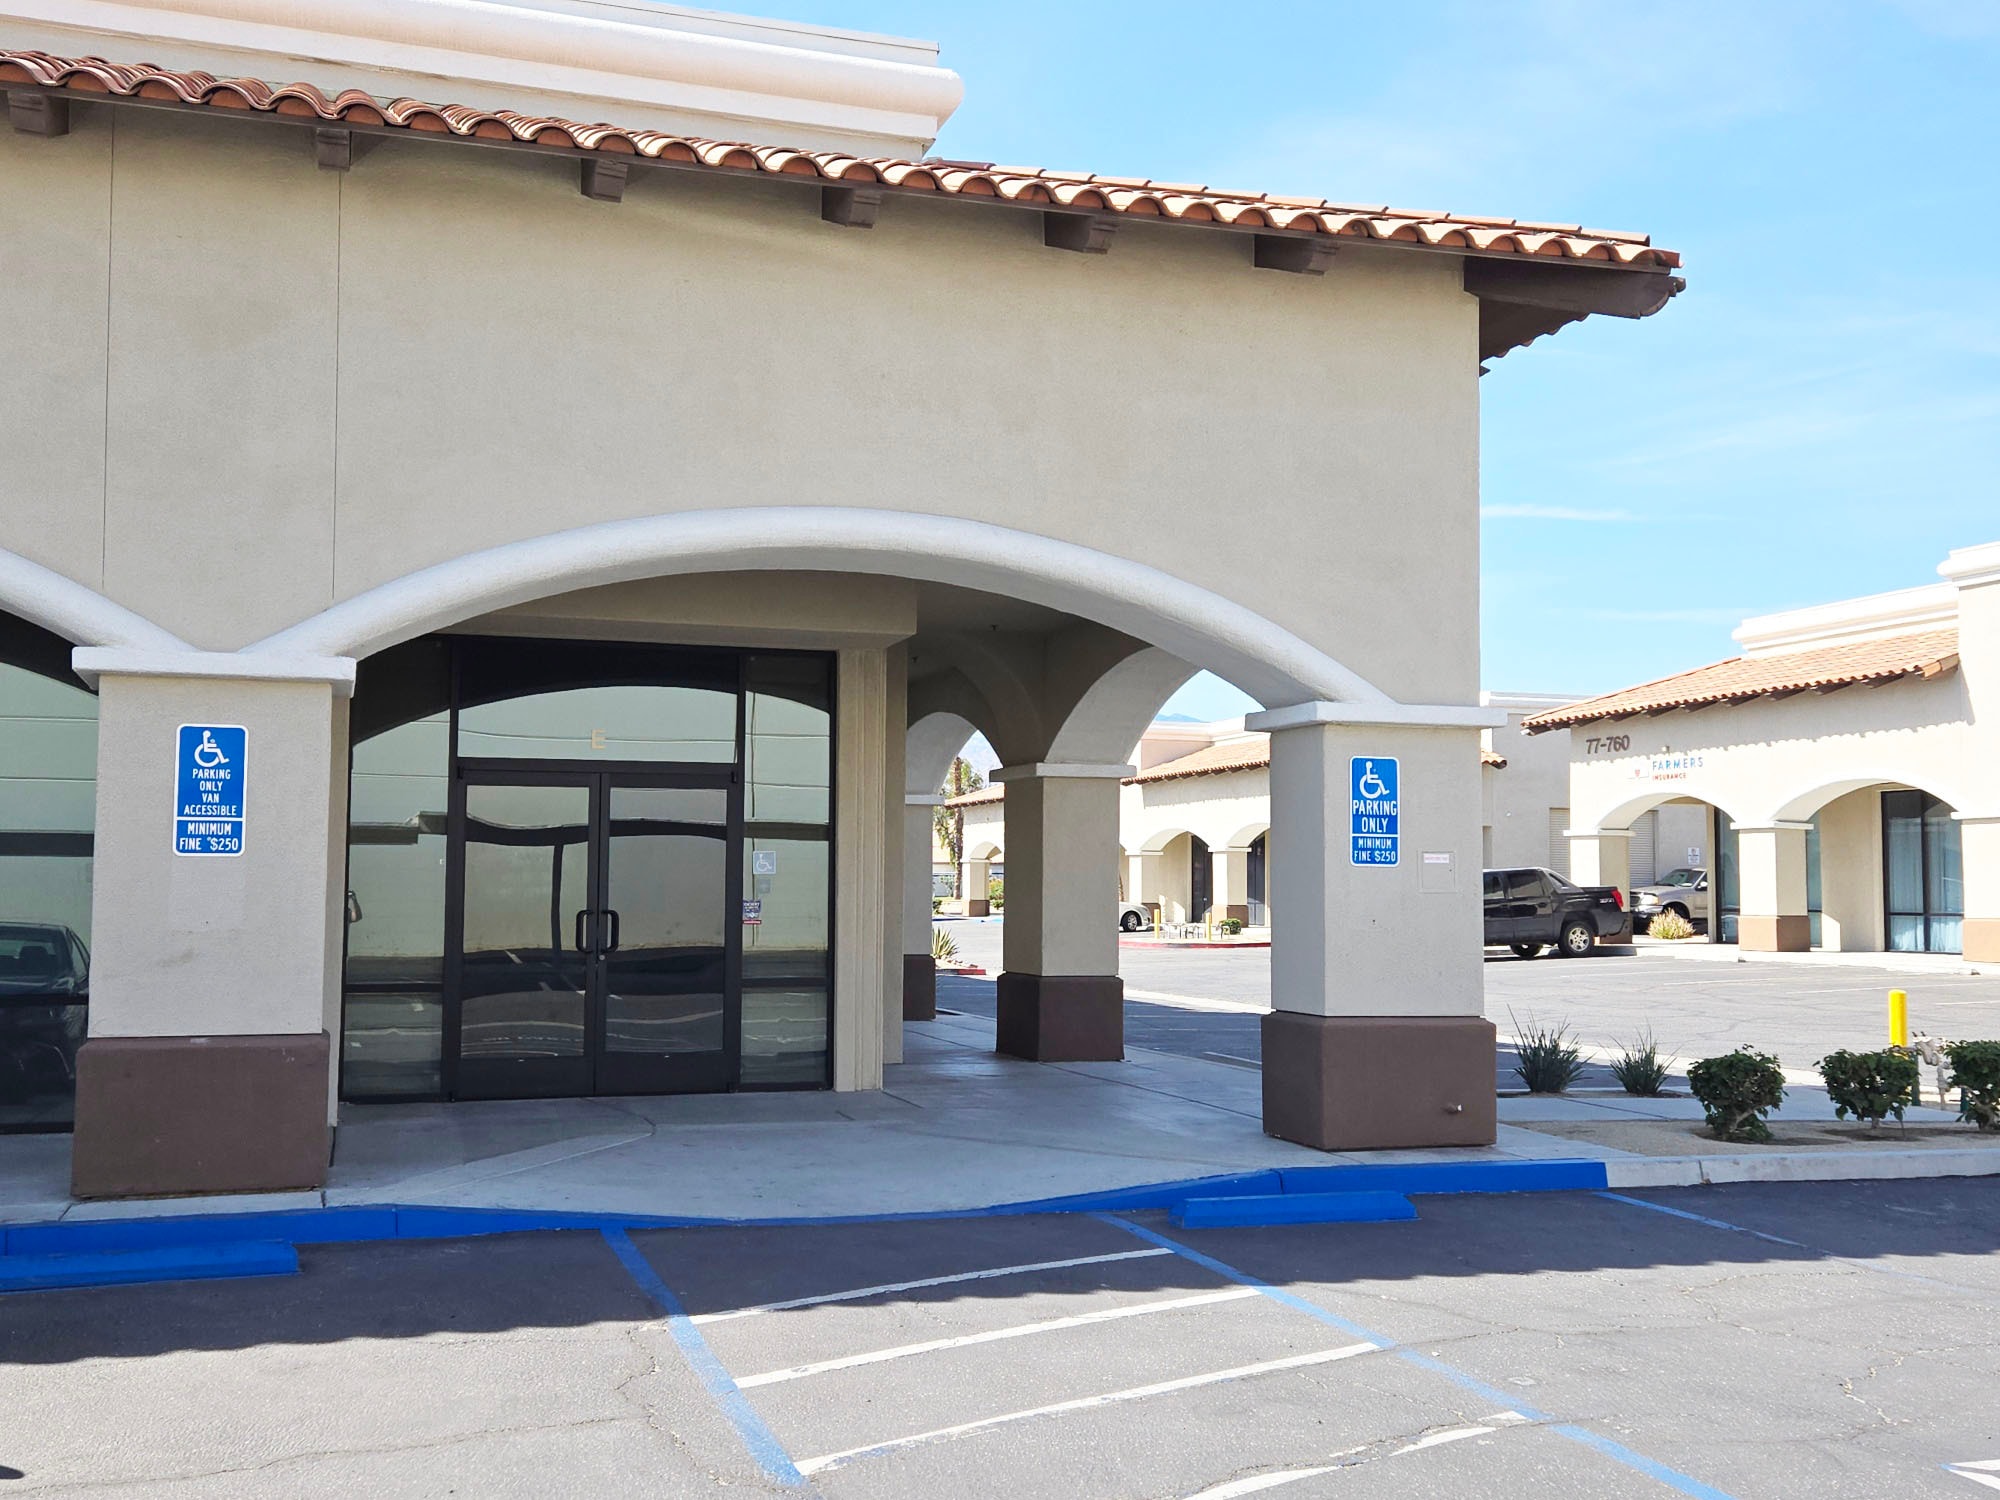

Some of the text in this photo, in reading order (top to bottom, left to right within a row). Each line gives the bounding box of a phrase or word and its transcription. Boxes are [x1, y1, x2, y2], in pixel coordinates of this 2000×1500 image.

[591, 728, 607, 750] E
[1586, 735, 1630, 754] 77-760
[1652, 757, 1704, 770] FARMERS
[192, 768, 231, 779] PARKING
[1652, 772, 1687, 781] INSURANCE
[199, 780, 223, 791] ONLY
[201, 793, 220, 803] VAN
[183, 804, 237, 816] ACCESSIBLE
[1352, 799, 1397, 815] PARKING
[187, 822, 232, 835] MINIMUM
[1361, 817, 1388, 833] ONLY
[179, 837, 239, 851] FINE $250
[1358, 838, 1392, 849] MINIMUM
[1354, 850, 1396, 862] FINE $250
